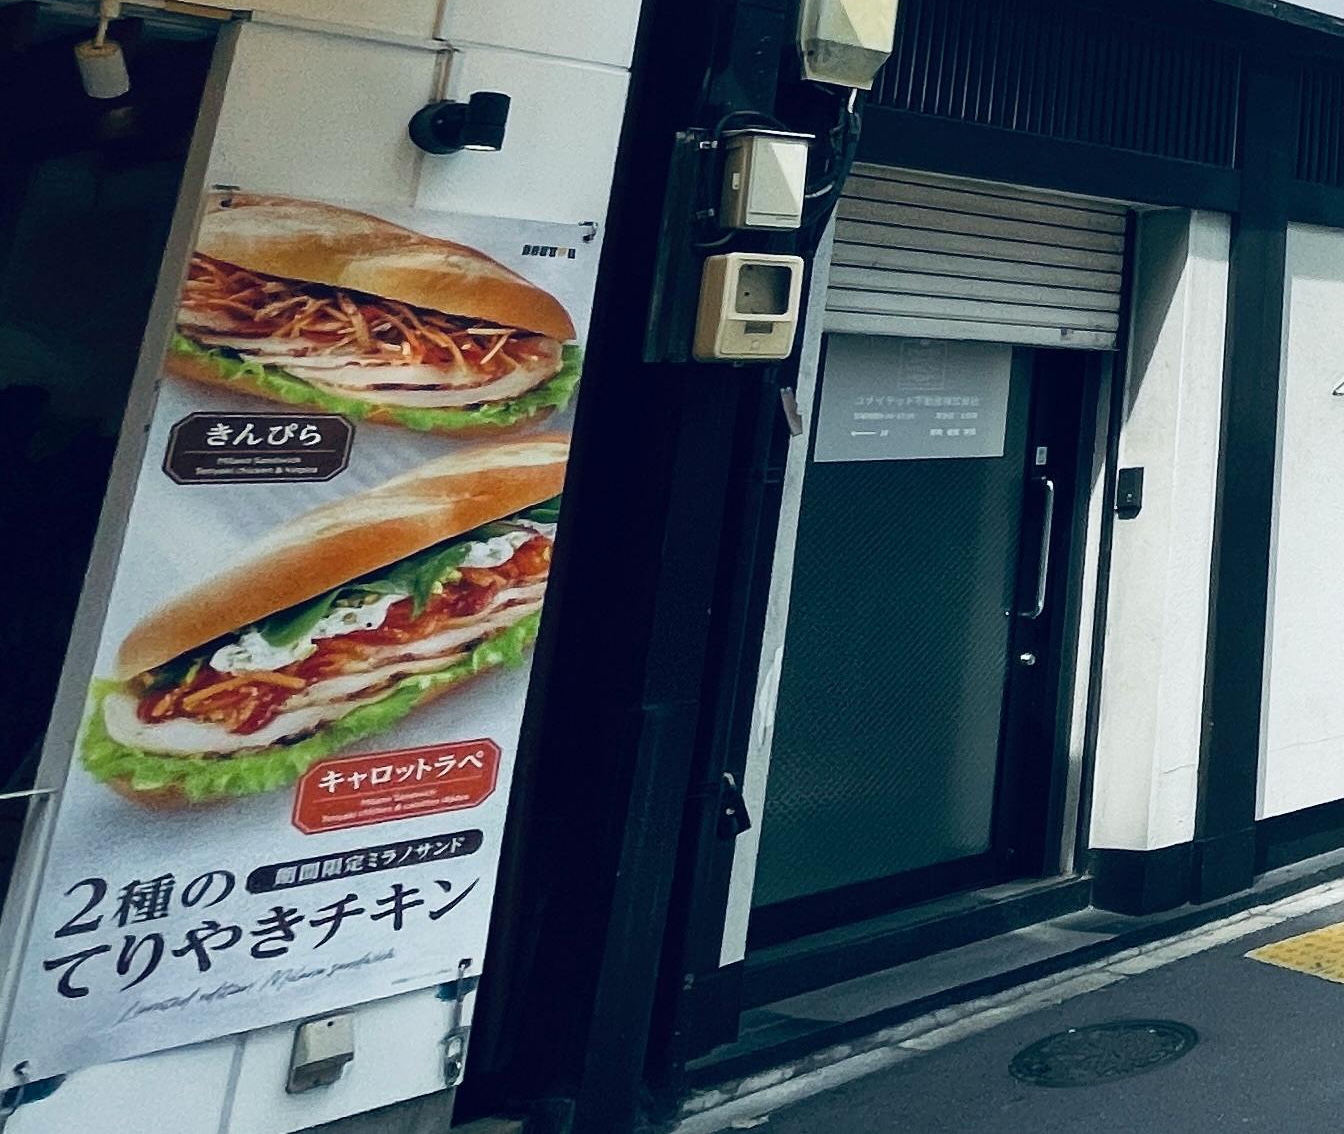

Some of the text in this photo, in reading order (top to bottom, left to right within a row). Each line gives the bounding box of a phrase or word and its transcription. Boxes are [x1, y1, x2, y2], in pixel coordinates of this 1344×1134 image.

[206, 422, 323, 447] きんぴら
[318, 750, 484, 793] キャロットラペ
[273, 836, 465, 887] 期間限定ミラノサンド
[54, 870, 236, 938] 2種の
[43, 878, 480, 998] てりやきチキン
